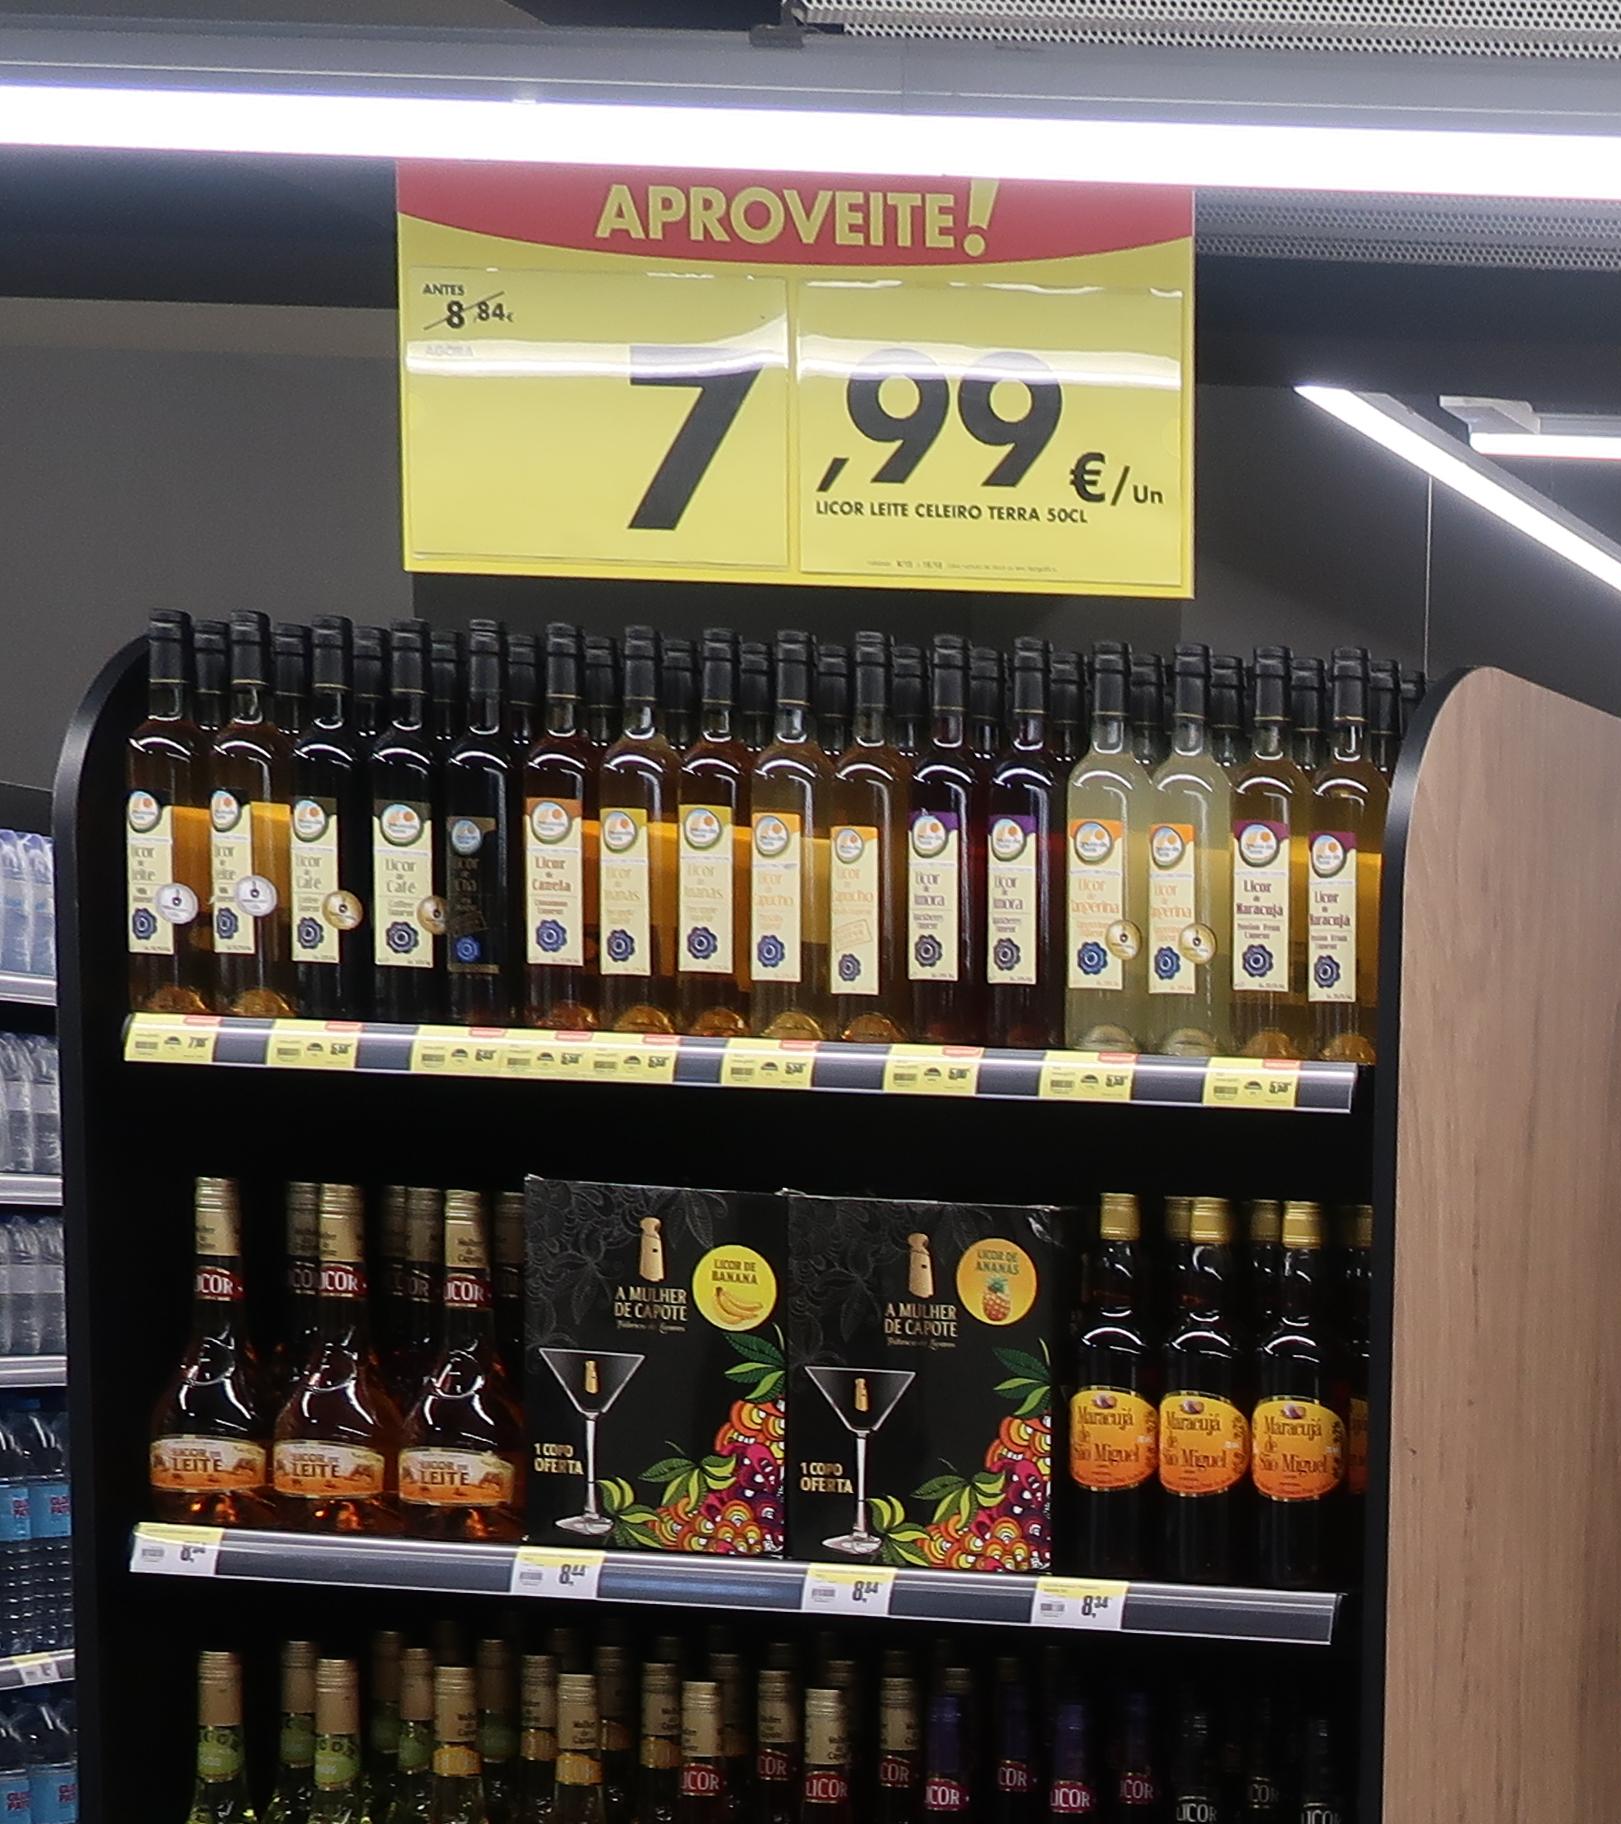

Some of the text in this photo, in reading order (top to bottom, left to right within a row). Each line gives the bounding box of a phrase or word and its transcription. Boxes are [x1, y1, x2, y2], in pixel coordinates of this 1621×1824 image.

[594, 179, 998, 257] APROVEITE!
[422, 283, 464, 296] ANTES
[628, 345, 766, 531] 7
[816, 501, 1088, 524] LICOR LEITE CELEIRO TERRA 50CL
[532, 878, 571, 892] Canela
[714, 1260, 756, 1271] LICOR DE
[711, 1270, 758, 1285] BANANA
[616, 1287, 686, 1304] A MULHER
[614, 1304, 688, 1321] DE CAPOTE
[886, 1303, 957, 1320] A MULHER
[884, 1319, 958, 1337] DE CAPOTE
[1078, 1406, 1133, 1426] Maracujá
[534, 1444, 573, 1457] 1 COPO
[1093, 1444, 1140, 1462] Miguel
[172, 1458, 223, 1471] LEITE
[293, 1463, 340, 1478] LEITE
[534, 1455, 583, 1474] OFERTA
[801, 1478, 853, 1493] OFERTA
